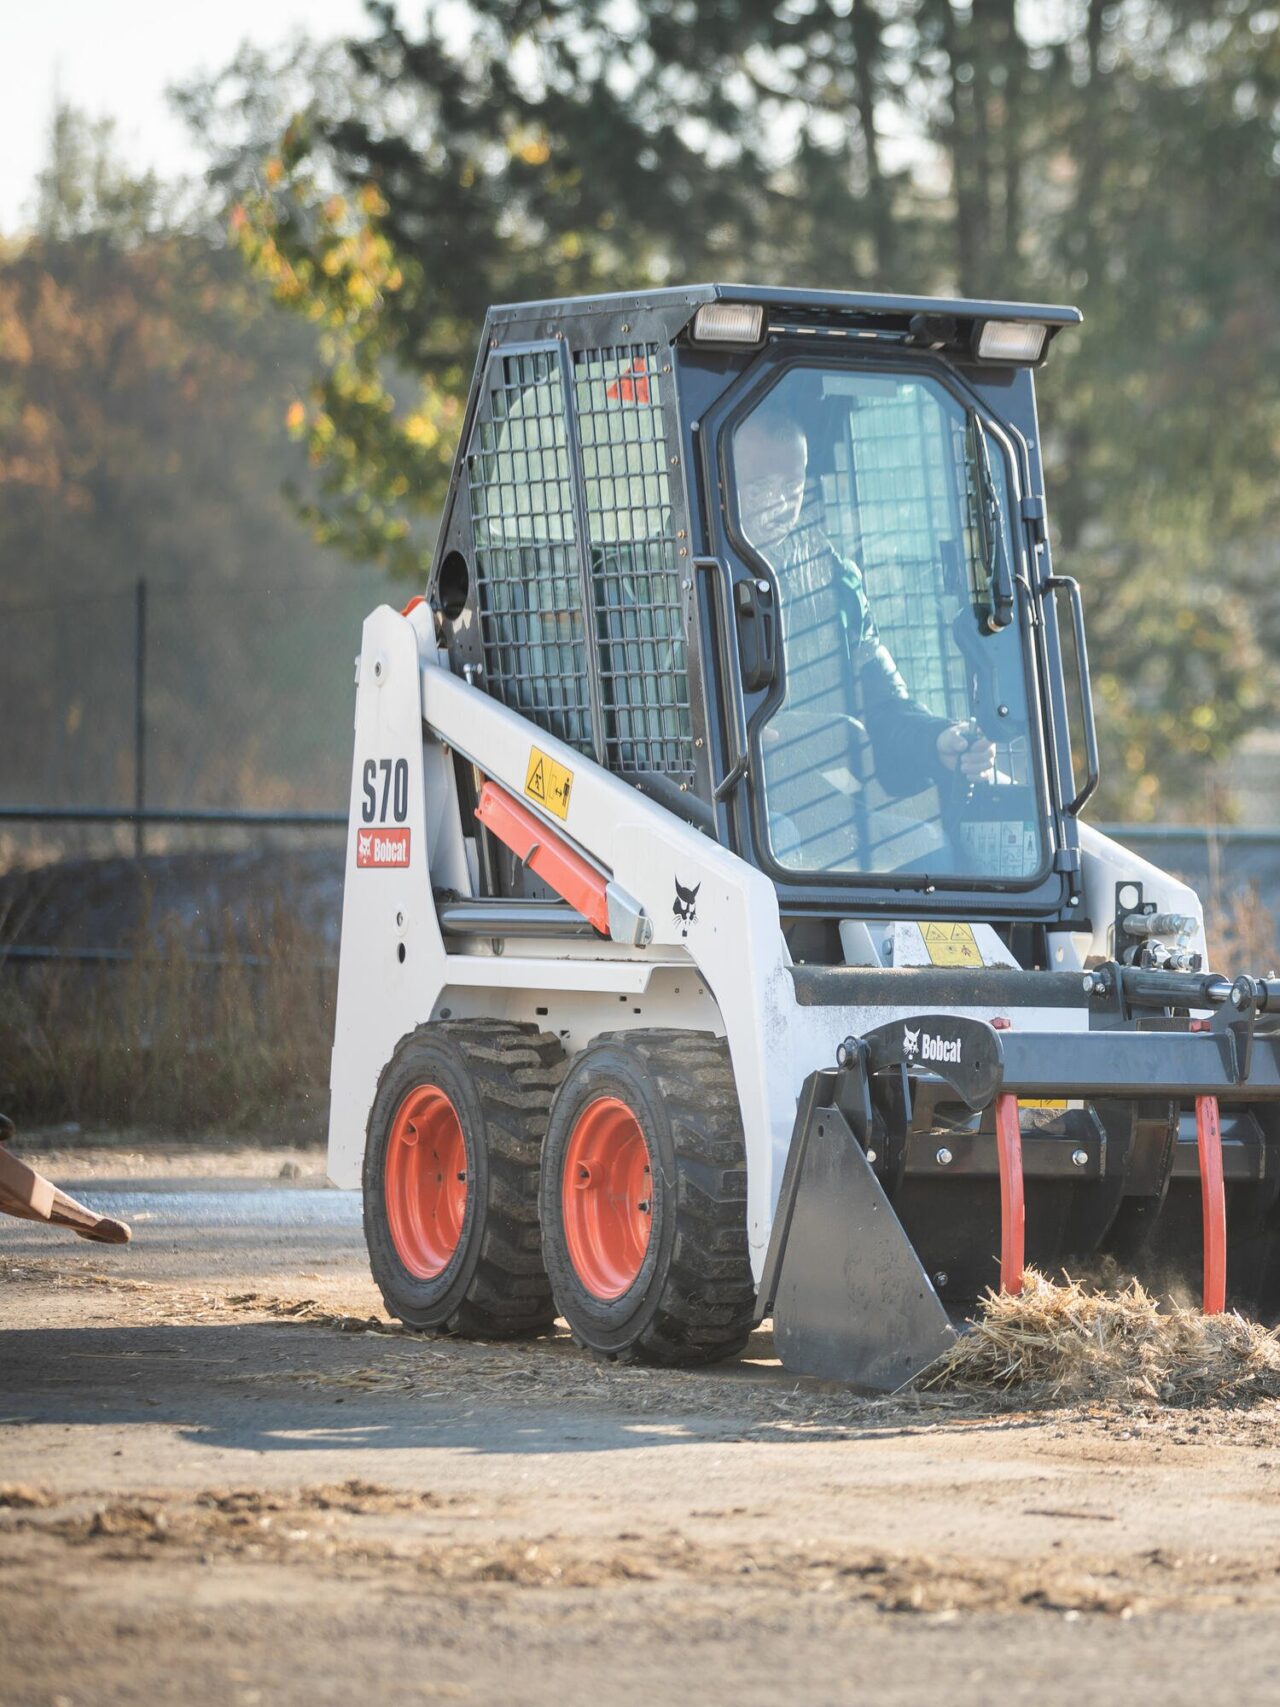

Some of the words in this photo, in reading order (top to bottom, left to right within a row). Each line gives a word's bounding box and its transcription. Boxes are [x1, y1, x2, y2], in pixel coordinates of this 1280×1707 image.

[362, 758, 409, 823] S70
[374, 838, 406, 862] Bobcat
[921, 1033, 962, 1063] Bobcat
